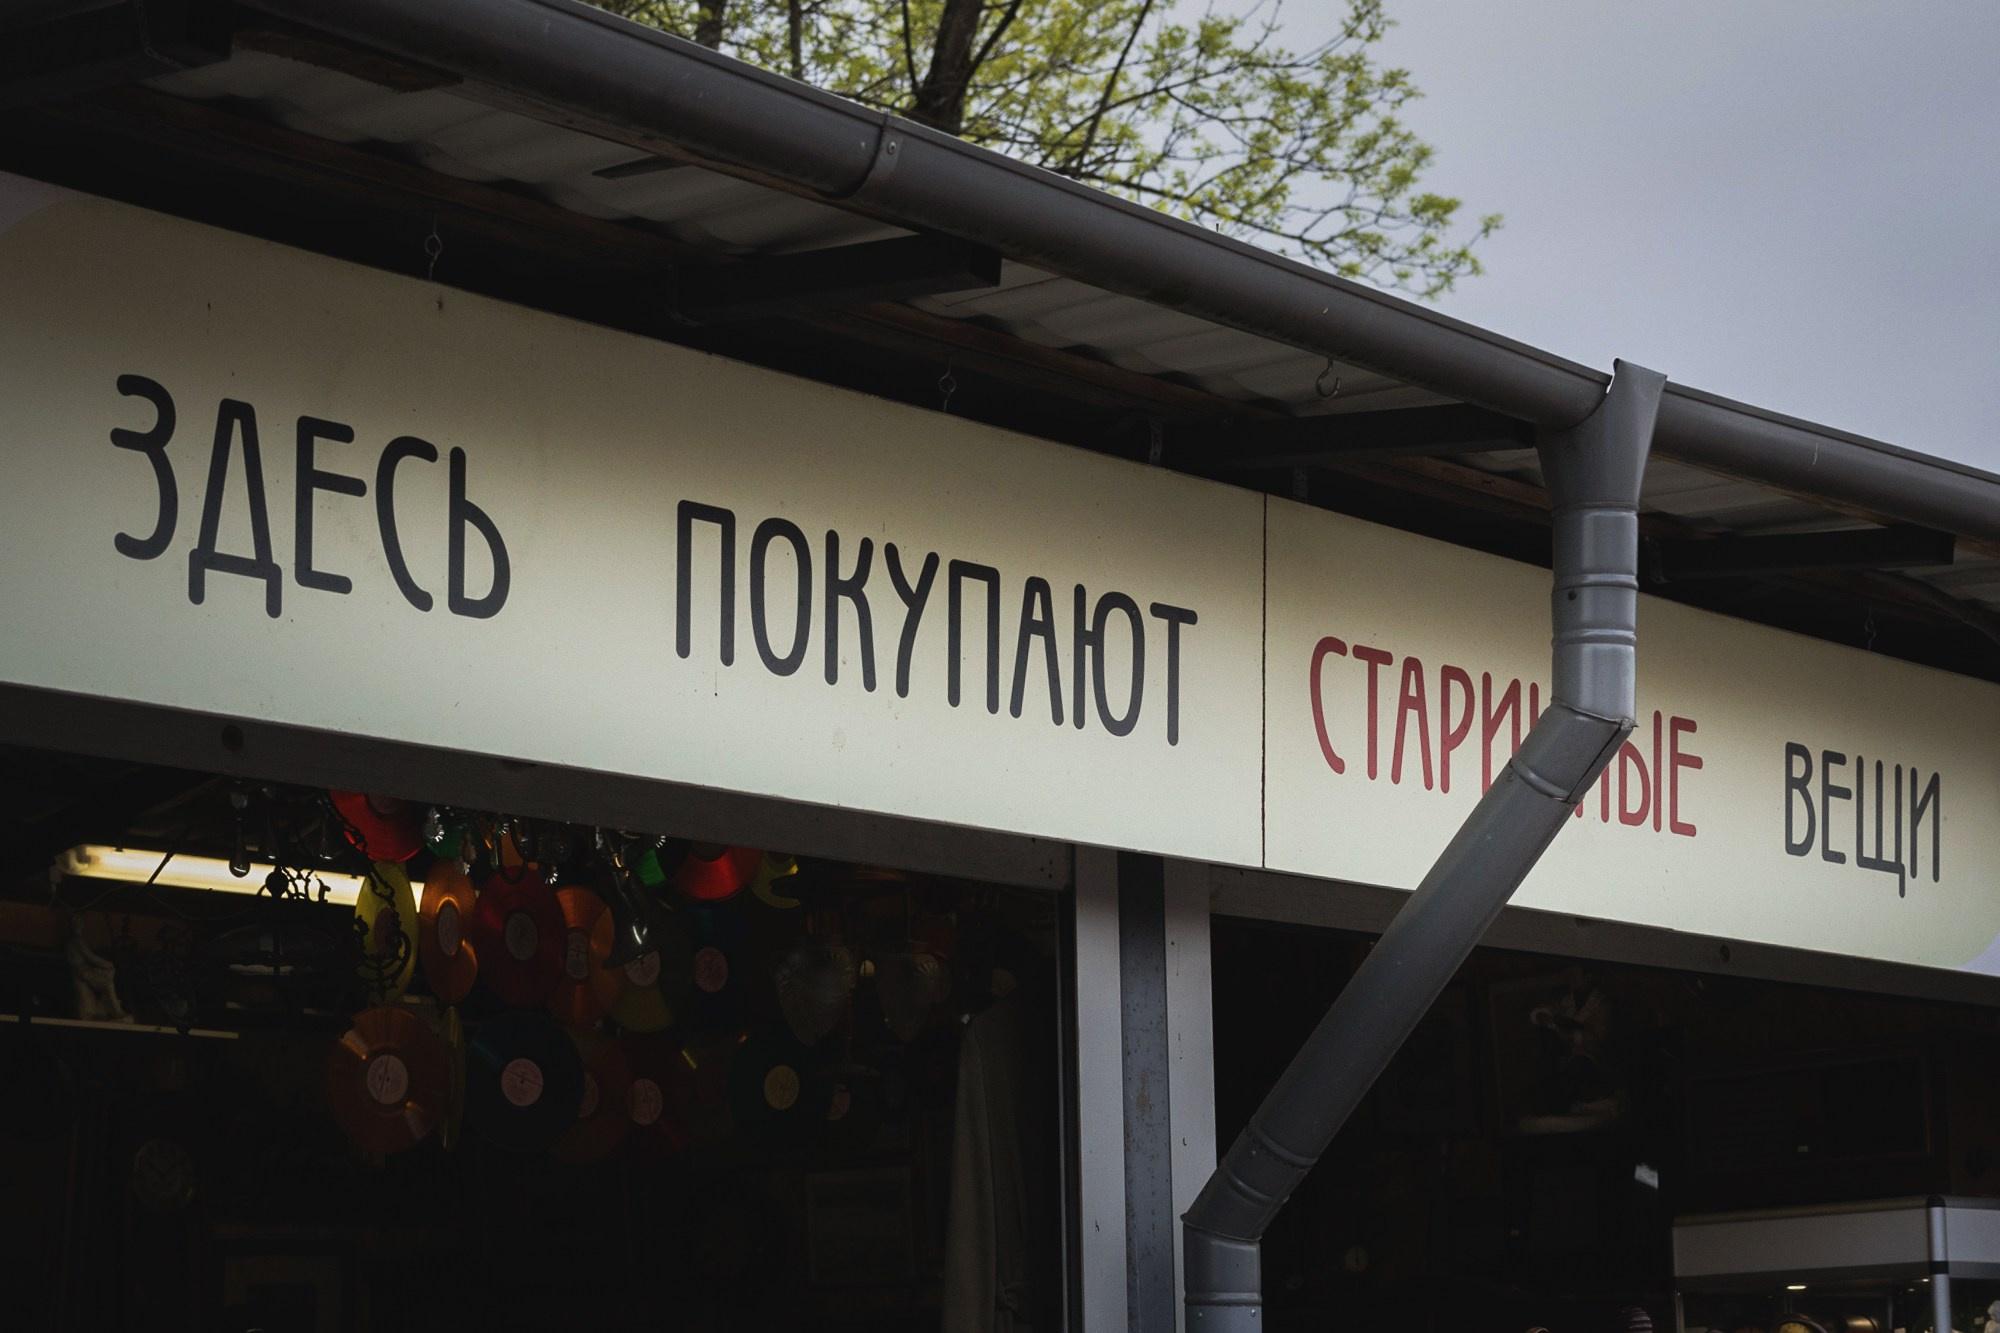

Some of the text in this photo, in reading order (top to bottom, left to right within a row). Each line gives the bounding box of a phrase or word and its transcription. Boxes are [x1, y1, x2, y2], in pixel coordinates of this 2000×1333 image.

[110, 374, 1941, 898] ЗДЕСЬ ПОКУПАЮТ СТАРИЫЕ ВЕЩИ
